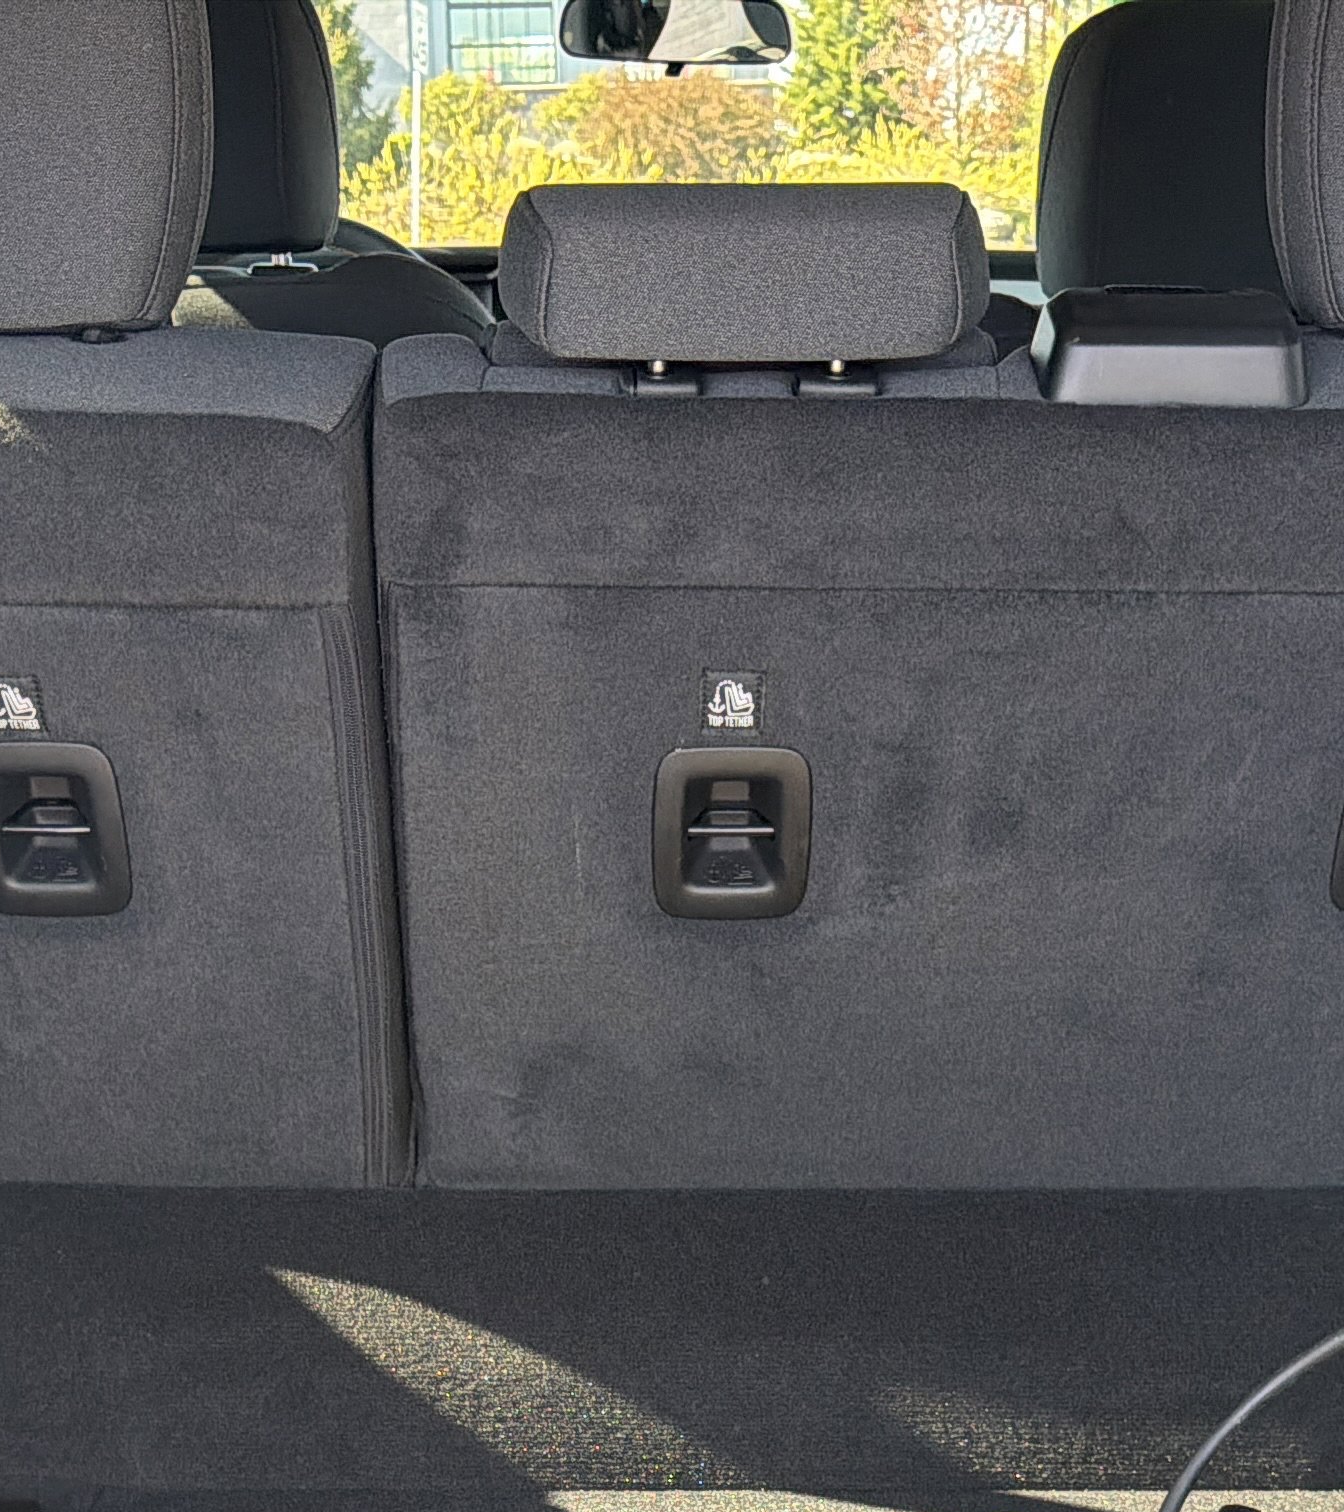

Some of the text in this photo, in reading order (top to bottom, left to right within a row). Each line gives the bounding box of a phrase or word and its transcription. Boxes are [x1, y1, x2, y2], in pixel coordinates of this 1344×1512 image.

[8, 718, 41, 730] TETHER
[707, 714, 754, 728] TOP TETHER
